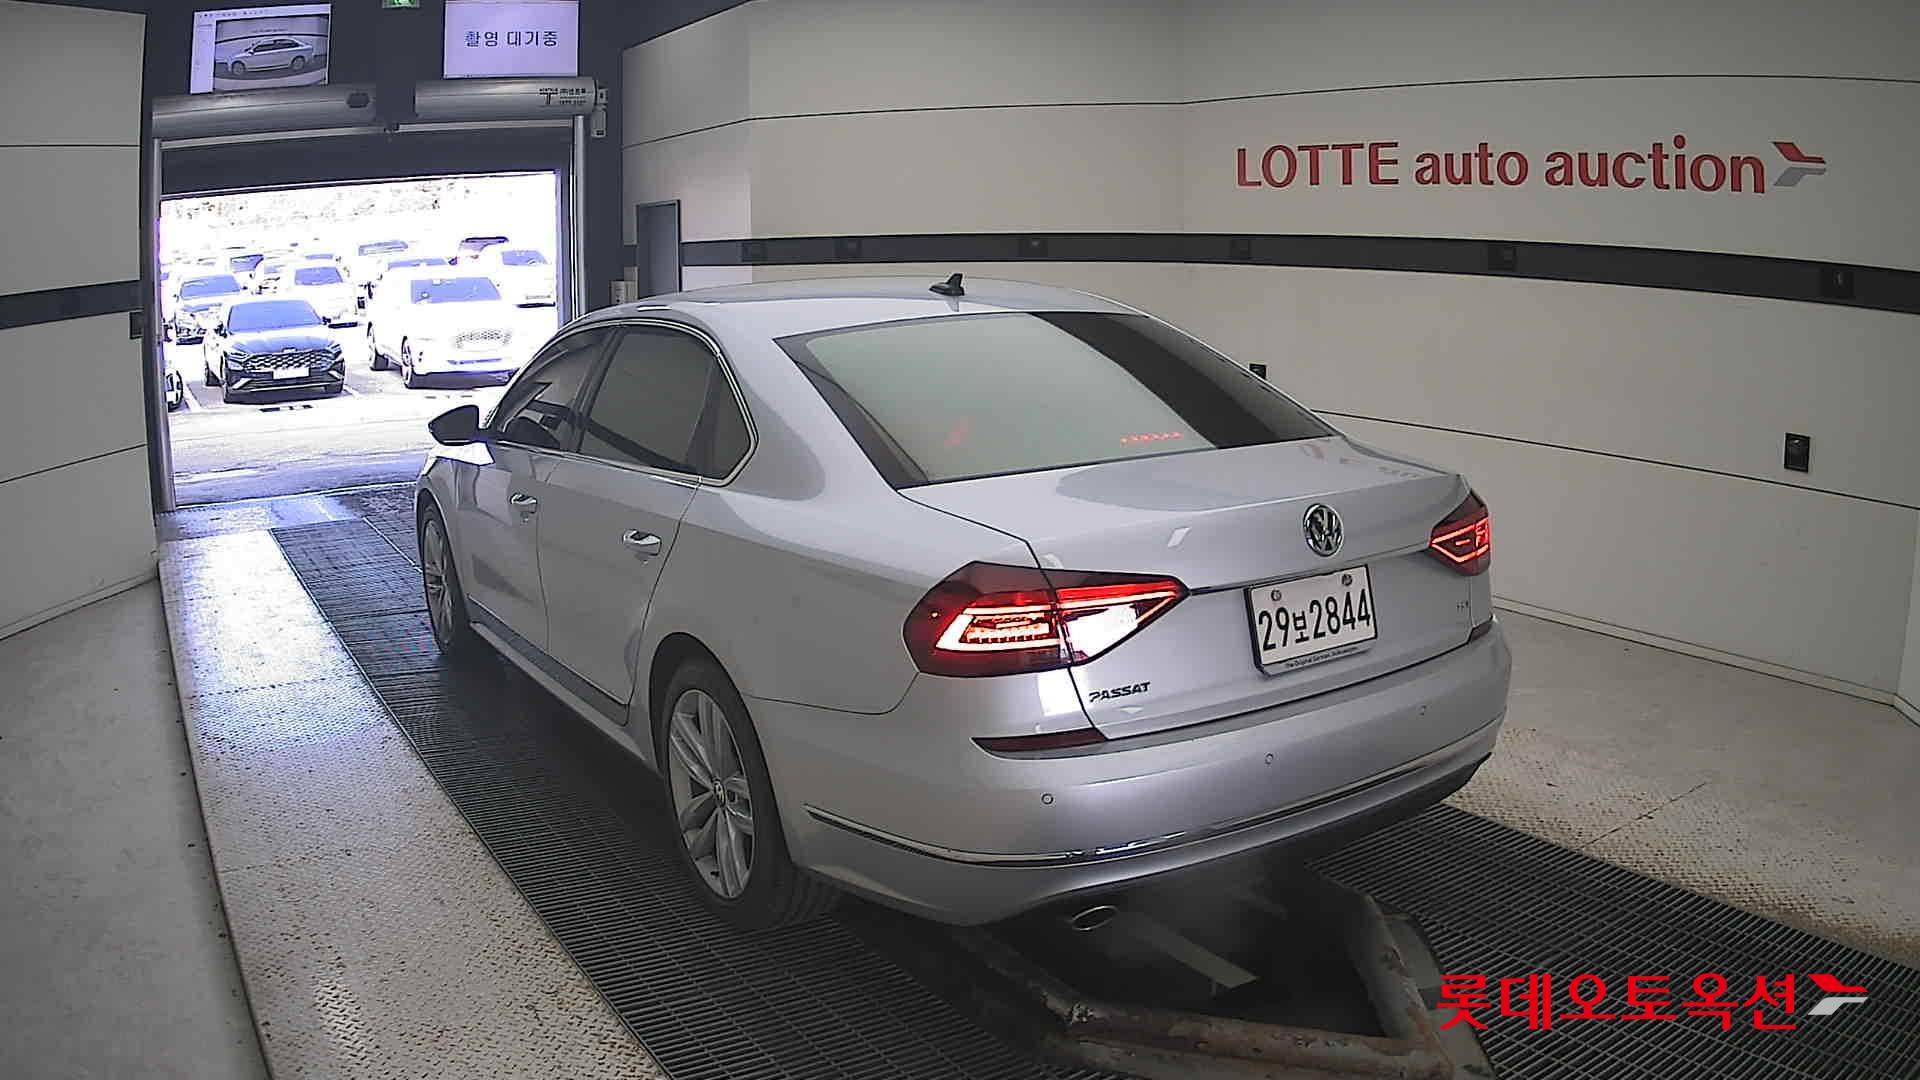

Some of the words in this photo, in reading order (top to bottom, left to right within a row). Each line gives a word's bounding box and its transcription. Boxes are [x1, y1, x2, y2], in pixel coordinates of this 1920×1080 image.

[465, 31, 499, 47] 촬영
[507, 31, 557, 47] 대기중
[1237, 143, 1399, 188] LOTTE
[1415, 143, 1529, 186] auto
[1545, 135, 1766, 194] auction
[1258, 588, 1371, 652] 29보2844
[1088, 681, 1151, 702] PASSAT
